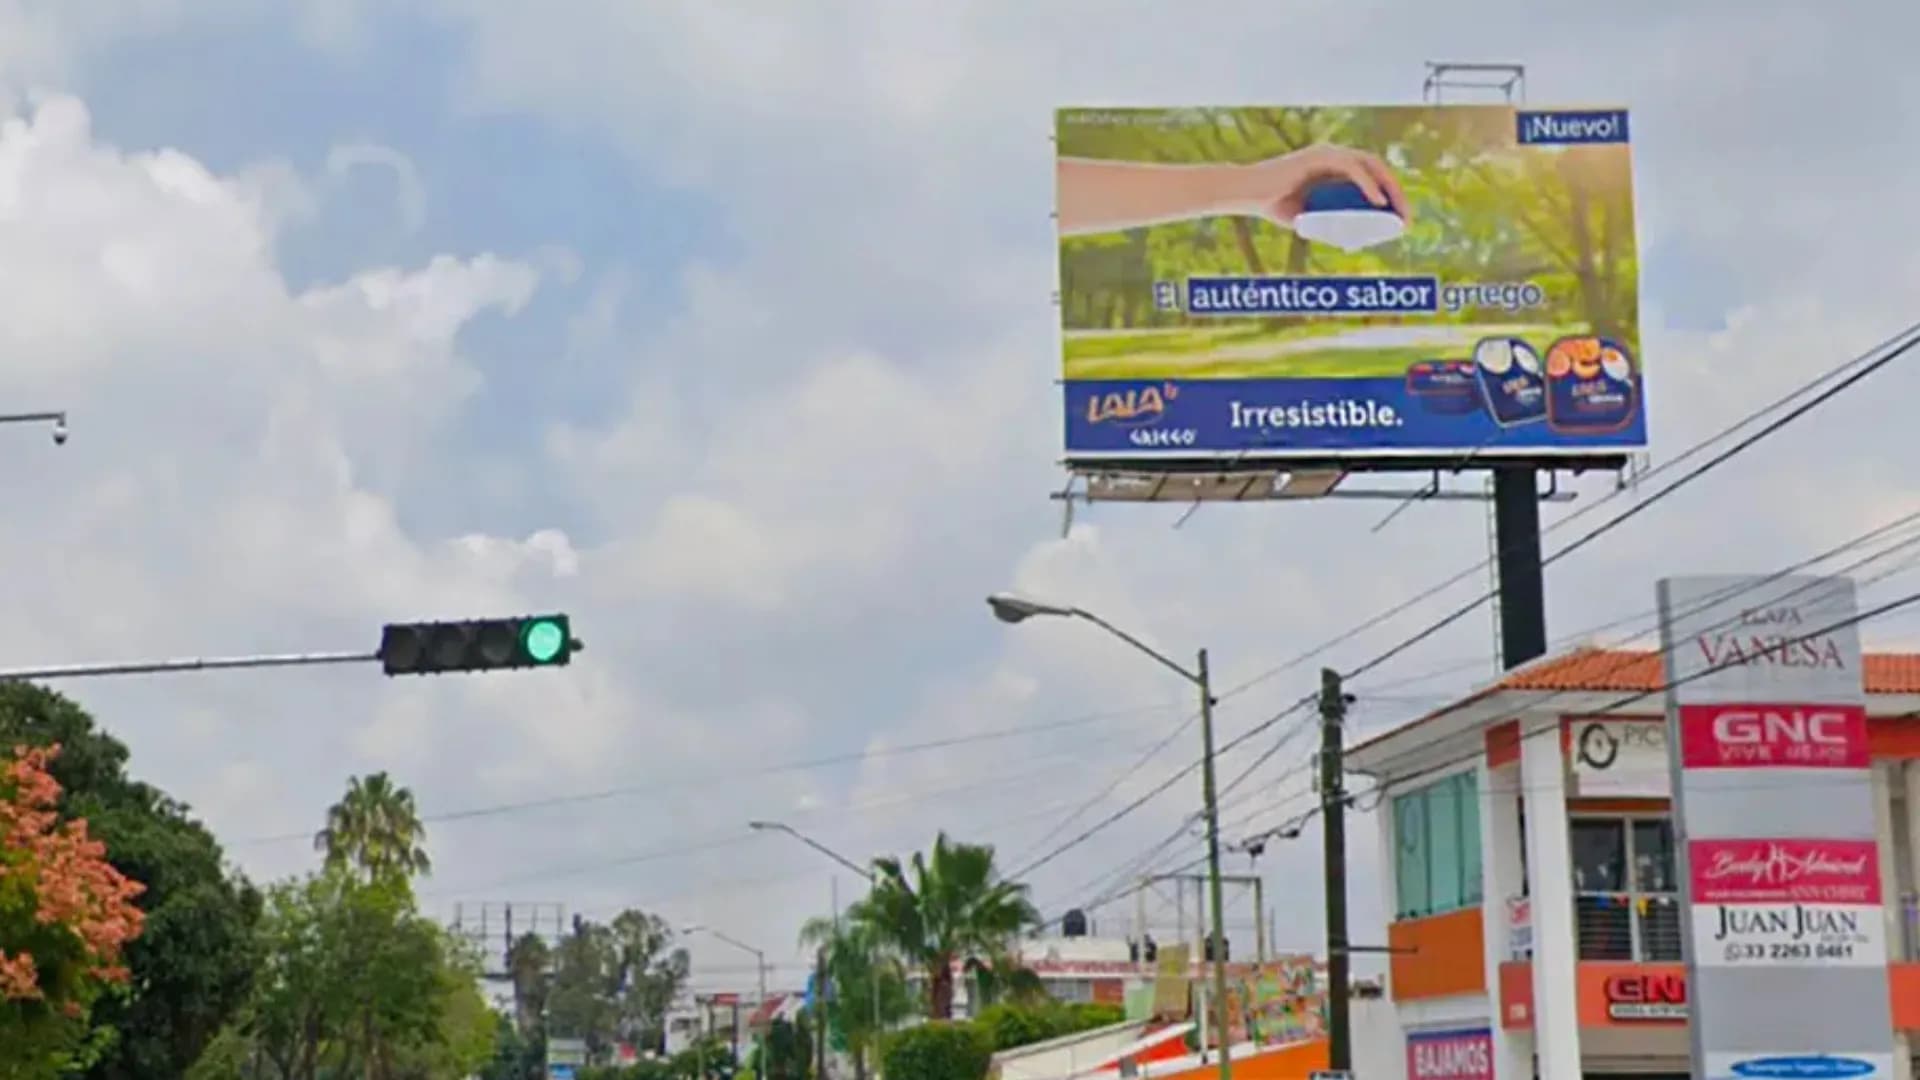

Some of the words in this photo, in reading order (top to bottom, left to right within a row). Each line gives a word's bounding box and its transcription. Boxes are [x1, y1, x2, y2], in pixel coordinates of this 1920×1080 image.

[1525, 113, 1618, 142] ¡Nuevo!
[1154, 280, 1181, 312] El
[1192, 279, 1338, 310] auténtico
[1346, 279, 1431, 308] sabor
[1086, 385, 1164, 424] LALA
[1230, 399, 1404, 429] Irresistible.
[1697, 632, 1846, 671] VANESA
[1712, 710, 1848, 745] GNC
[1714, 904, 1788, 940] JUAN
[1792, 904, 1858, 940] JUAN
[1743, 943, 1765, 959] 33
[1414, 1041, 1489, 1077] BAJAMOS
